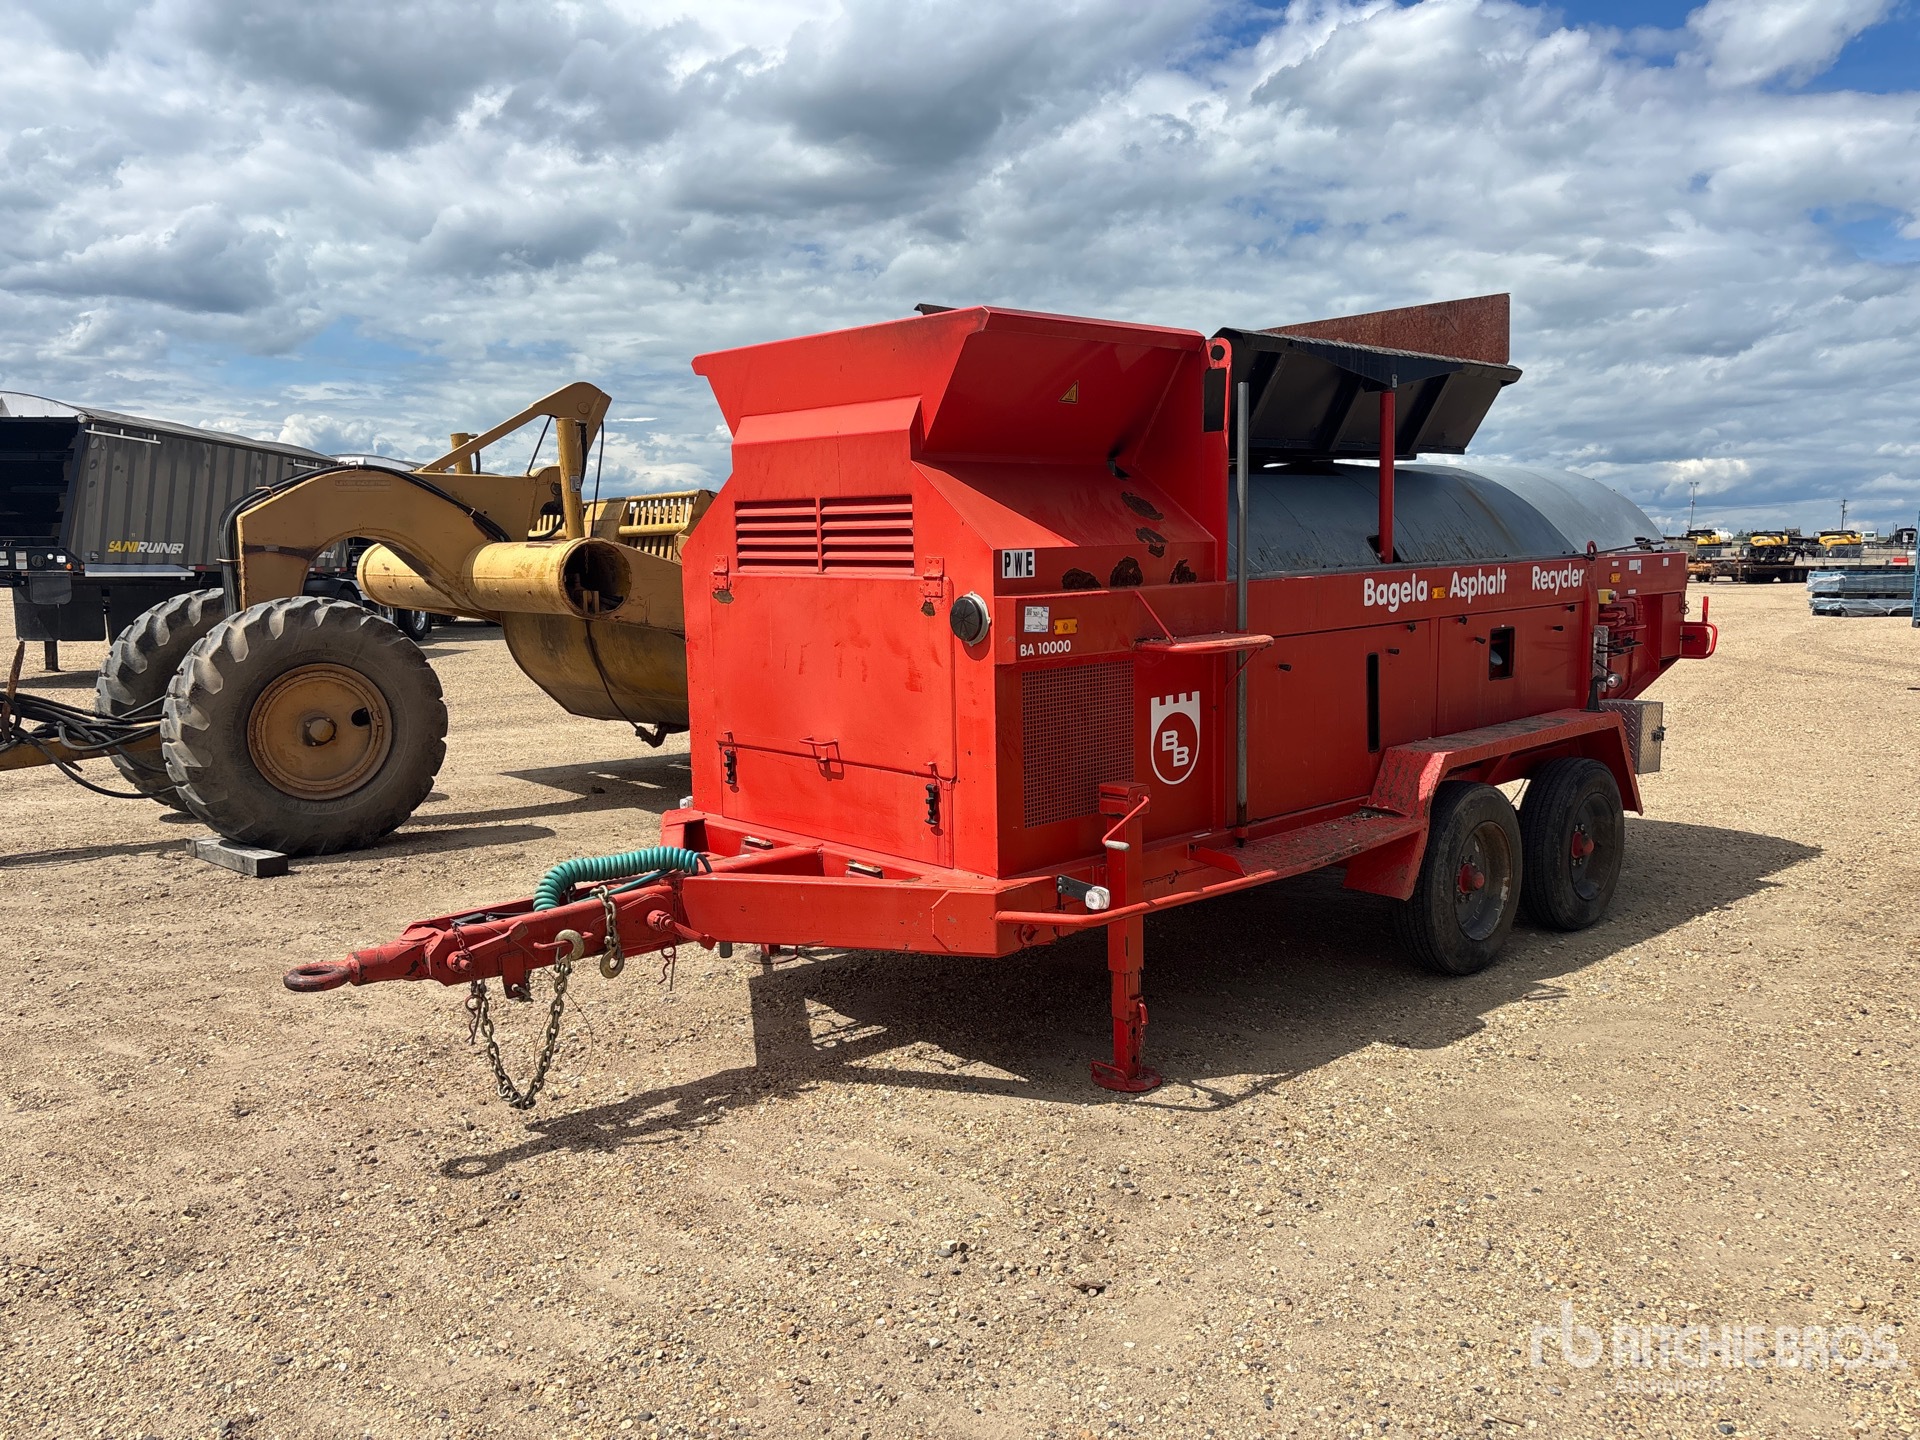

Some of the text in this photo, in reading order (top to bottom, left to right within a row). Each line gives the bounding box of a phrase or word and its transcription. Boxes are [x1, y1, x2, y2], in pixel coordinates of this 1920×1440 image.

[1004, 551, 1033, 577] PWE
[1363, 562, 1585, 613] Bagela Asphalt Recycler
[1020, 639, 1072, 657] BA 10000
